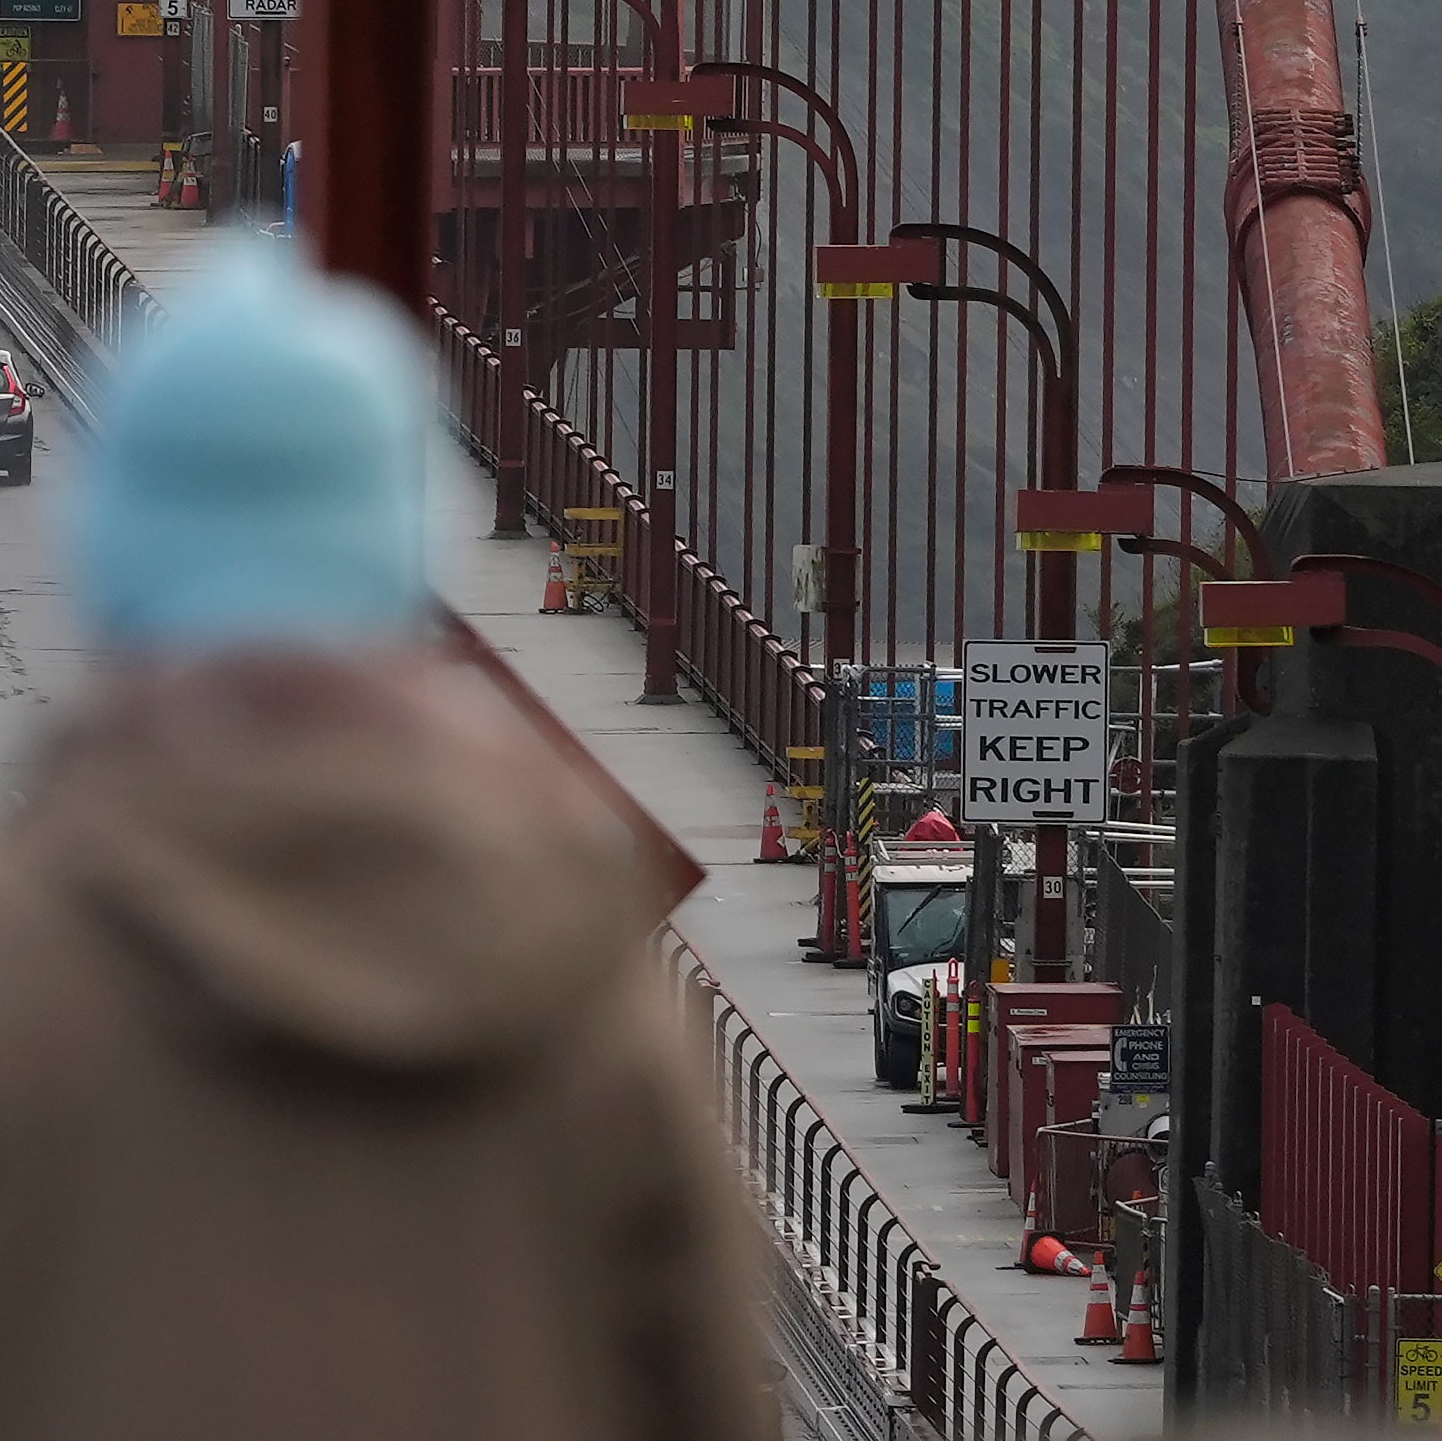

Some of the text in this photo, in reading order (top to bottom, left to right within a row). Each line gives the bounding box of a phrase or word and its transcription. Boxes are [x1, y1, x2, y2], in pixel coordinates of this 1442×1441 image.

[168, 0, 178, 15] 5
[246, 0, 297, 10] RADAR
[265, 109, 276, 120] 40
[507, 331, 519, 343] 36
[658, 474, 671, 486] 34
[970, 664, 1101, 684] SLOWER
[969, 699, 1101, 719] TRAFFIC
[979, 736, 1089, 761] KEEP
[970, 777, 1099, 804] RIGHT
[1044, 880, 1061, 894] 30
[1114, 1029, 1165, 1037] EMERGENCY
[1129, 1041, 1164, 1050] PHONE
[1401, 1365, 1442, 1376] SPEED
[1405, 1380, 1438, 1391] LIMIT
[1412, 1393, 1431, 1421] 5
